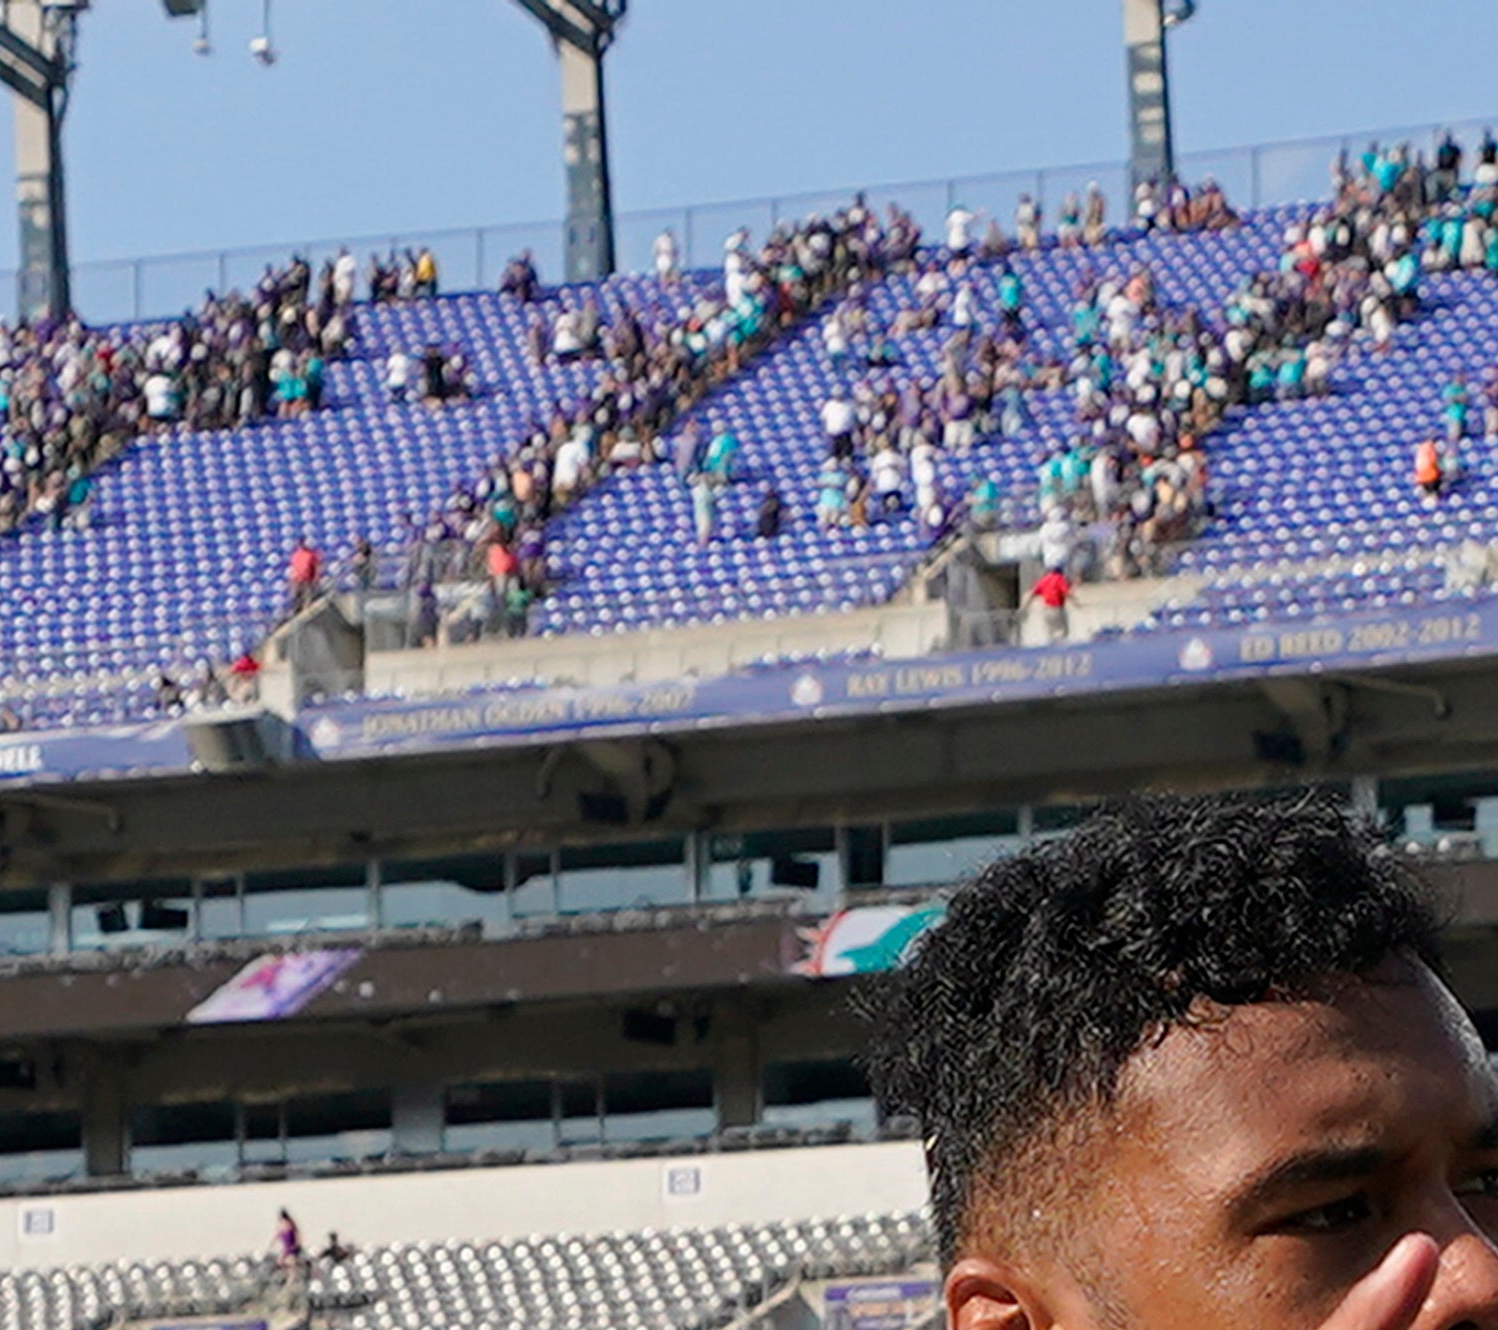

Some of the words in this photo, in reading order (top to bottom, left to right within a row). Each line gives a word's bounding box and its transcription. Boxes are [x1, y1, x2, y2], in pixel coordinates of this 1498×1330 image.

[1240, 635, 1274, 661] ED
[1278, 628, 1343, 658] REED
[895, 664, 965, 694] LEWIS
